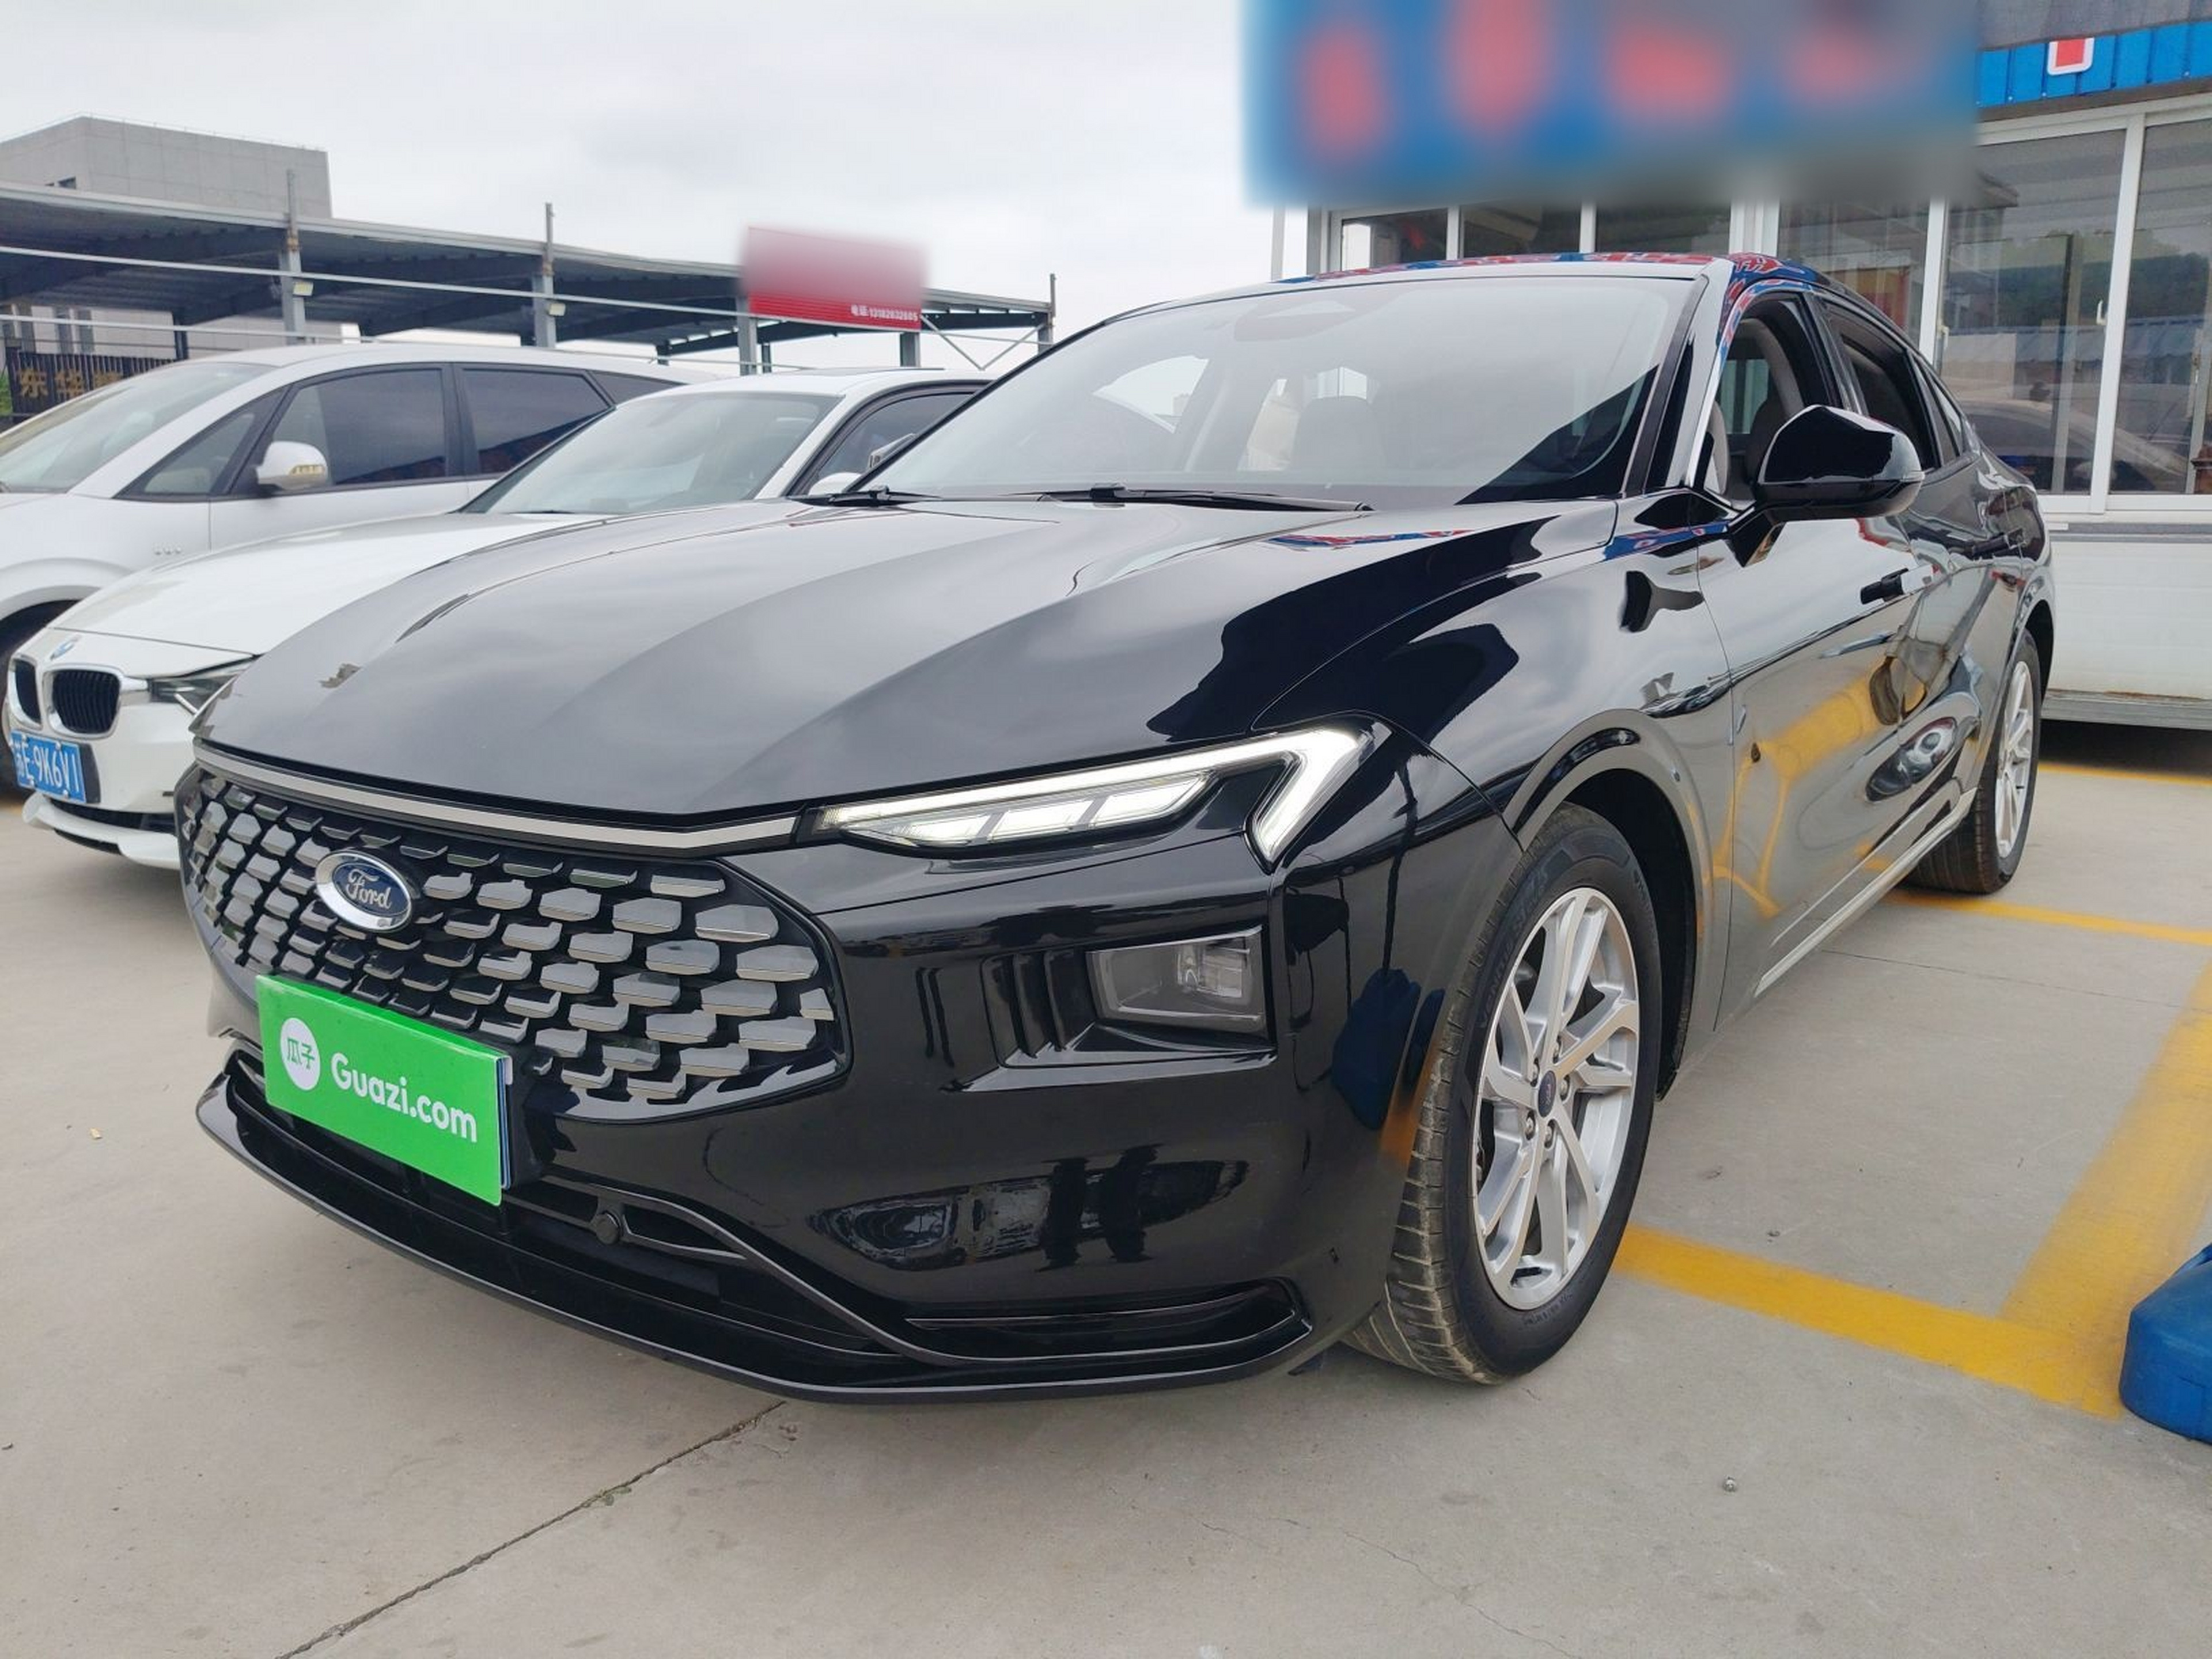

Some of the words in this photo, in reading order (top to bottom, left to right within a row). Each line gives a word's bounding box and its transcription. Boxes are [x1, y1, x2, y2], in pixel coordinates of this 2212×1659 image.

[346, 868, 392, 909] Ford
[287, 1038, 315, 1070] 瓜子
[331, 1052, 477, 1143] Guazi.com
